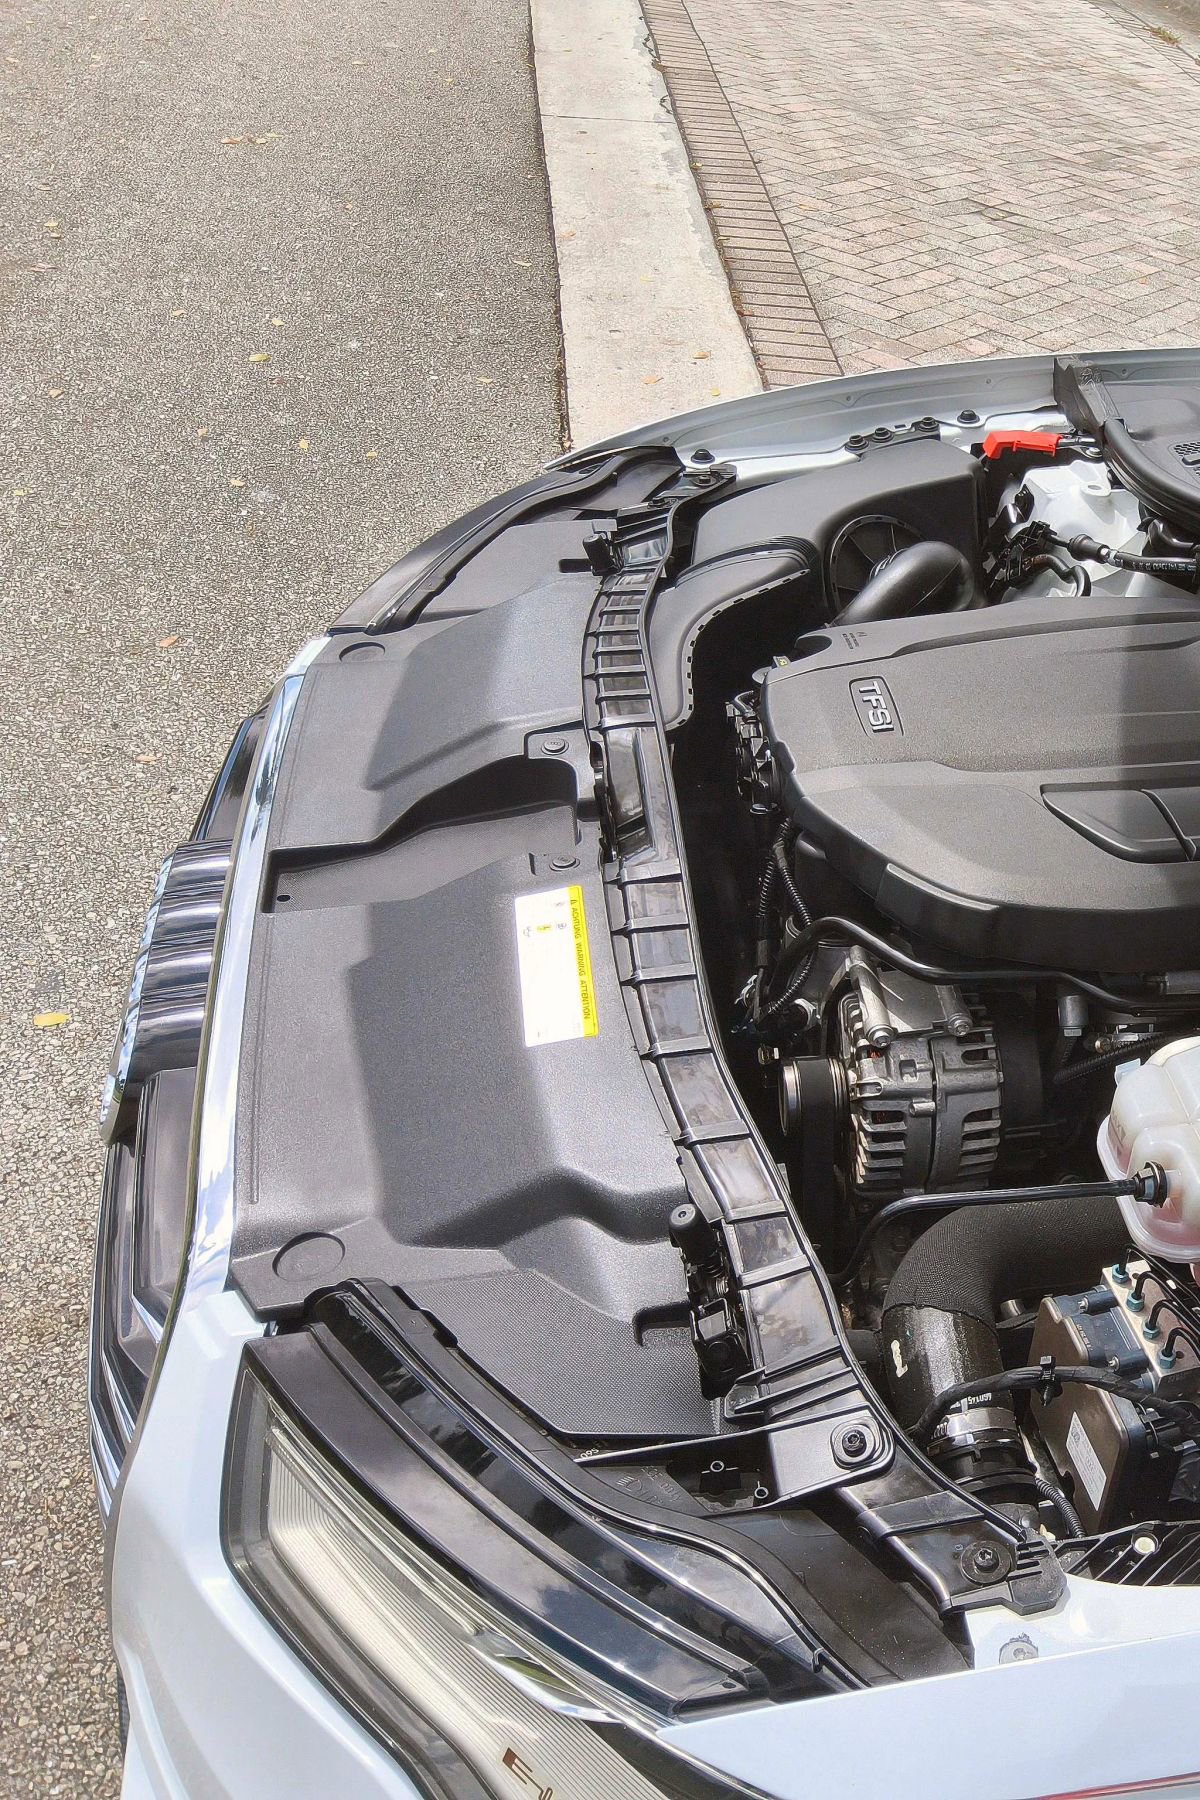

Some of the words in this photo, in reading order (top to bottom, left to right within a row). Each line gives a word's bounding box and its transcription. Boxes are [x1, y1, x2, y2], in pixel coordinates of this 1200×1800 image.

[858, 681, 895, 733] TFSI
[571, 907, 581, 939] ACHTUNG
[575, 942, 586, 976] WARNING
[579, 980, 591, 1020] ATTENTION
